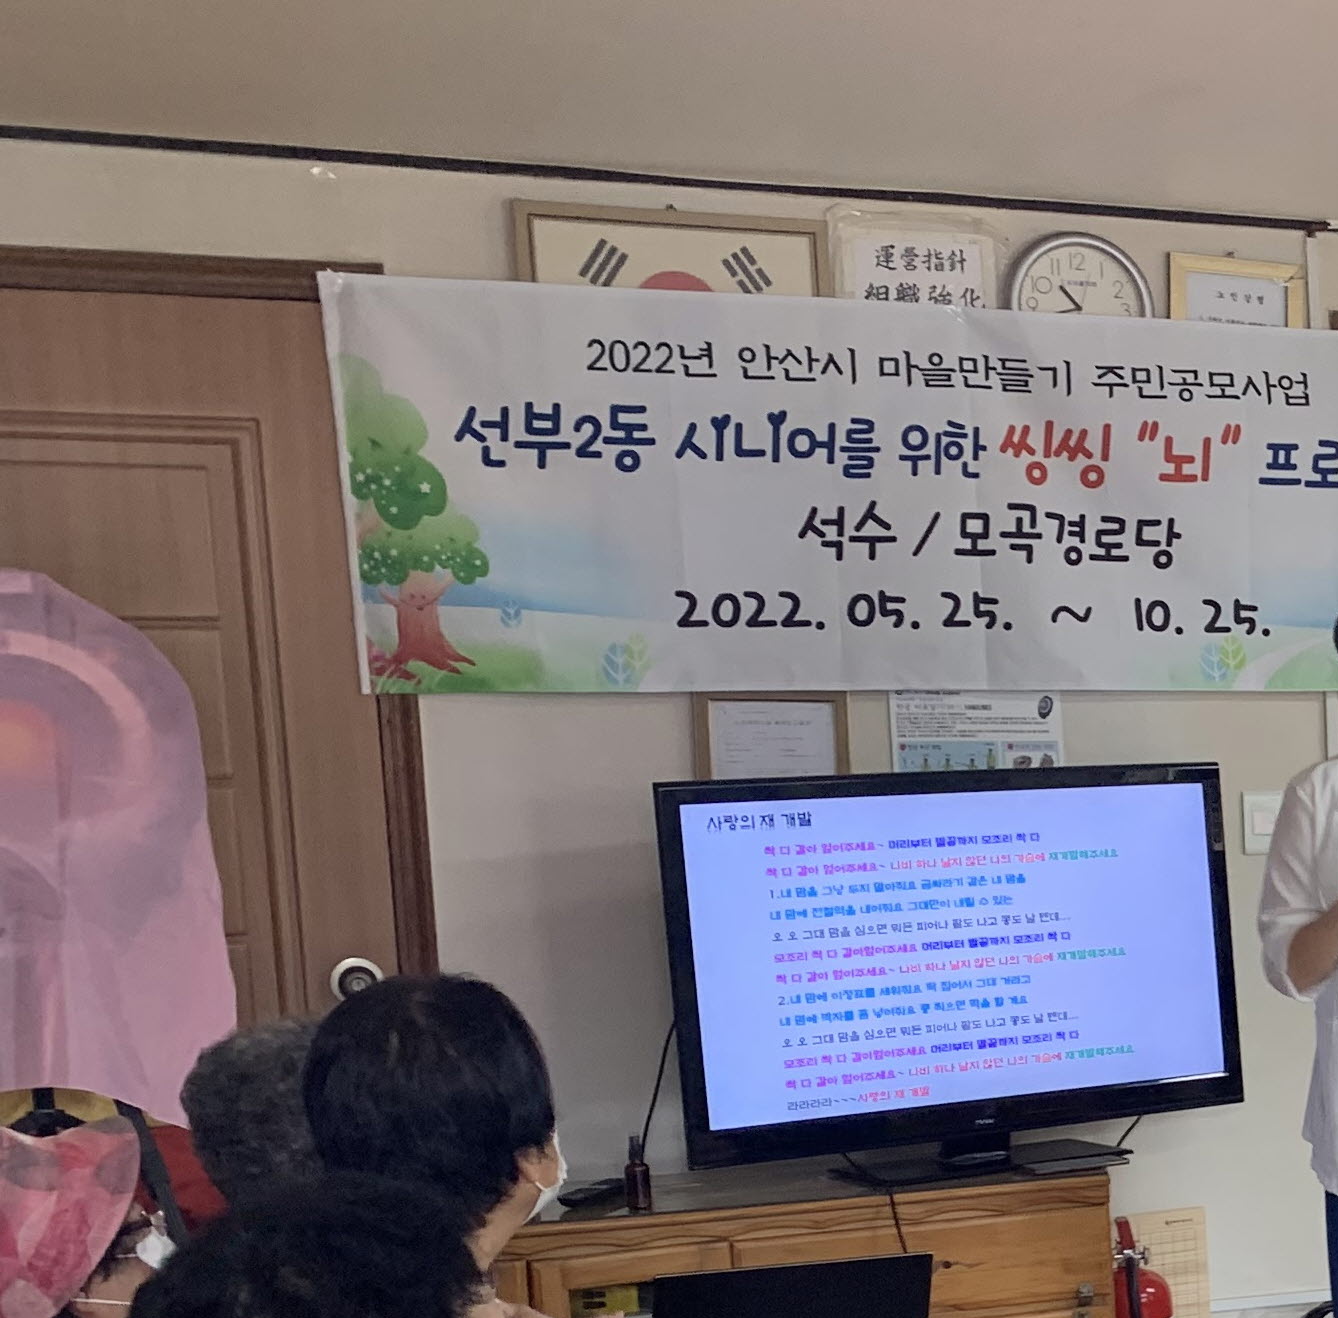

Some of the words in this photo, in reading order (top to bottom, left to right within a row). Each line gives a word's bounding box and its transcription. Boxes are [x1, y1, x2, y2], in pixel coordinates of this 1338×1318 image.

[1068, 252, 1086, 271] 12
[1030, 275, 1053, 295] 10
[1112, 280, 1124, 299] 2
[586, 338, 718, 378] 2022년
[737, 343, 857, 385] 안산시
[878, 350, 1072, 397] 마을만들기
[1090, 364, 1311, 407] 주민공모사업
[453, 401, 657, 473] 선부2동
[674, 409, 882, 480] 시니어를
[898, 419, 988, 480] 위한
[999, 419, 1112, 489] 씽씽
[797, 499, 898, 562] 석수
[953, 506, 1183, 570] 모곡경로당
[674, 589, 826, 631] 2022.
[846, 589, 921, 630] 05.
[940, 590, 1013, 632] 25.
[1134, 597, 1184, 636] 10.
[1201, 597, 1271, 638] 25.
[705, 814, 755, 831] 사랑의
[758, 813, 775, 828] 재
[779, 811, 813, 827] 개발
[976, 915, 998, 927] 나고
[984, 1016, 1006, 1029] 나고
